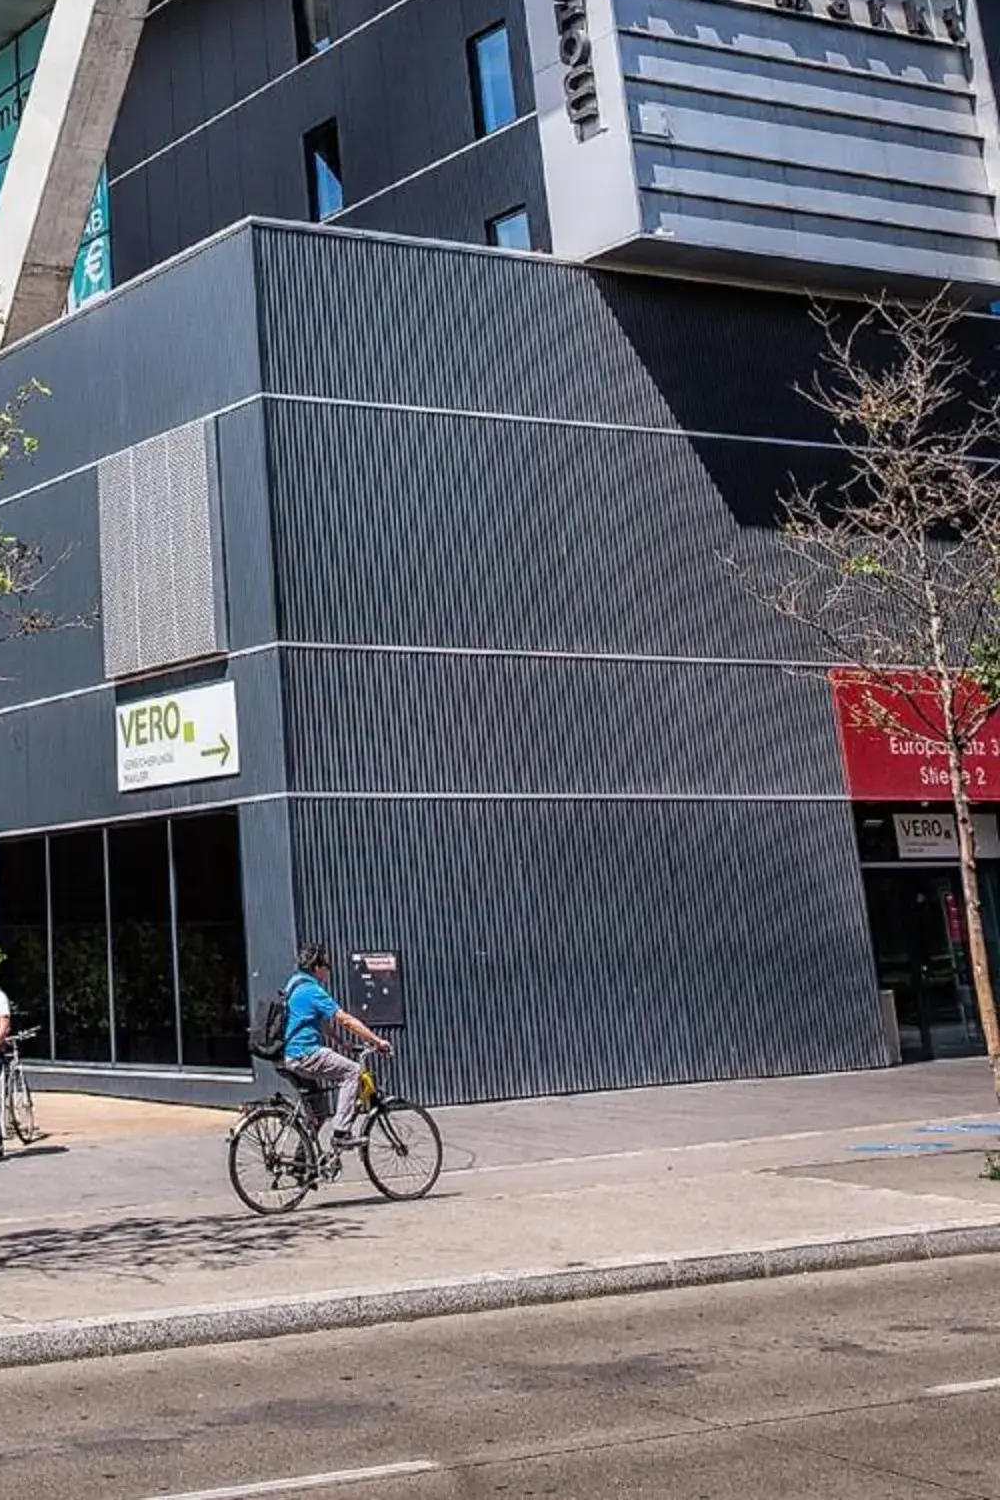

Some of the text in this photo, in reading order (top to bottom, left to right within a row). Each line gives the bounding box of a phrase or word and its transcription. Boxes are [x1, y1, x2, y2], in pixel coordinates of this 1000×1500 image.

[119, 701, 181, 749] VERO
[889, 736, 986, 758] Europaatz
[919, 766, 987, 786] Stiee 2
[899, 819, 943, 837] VERO
